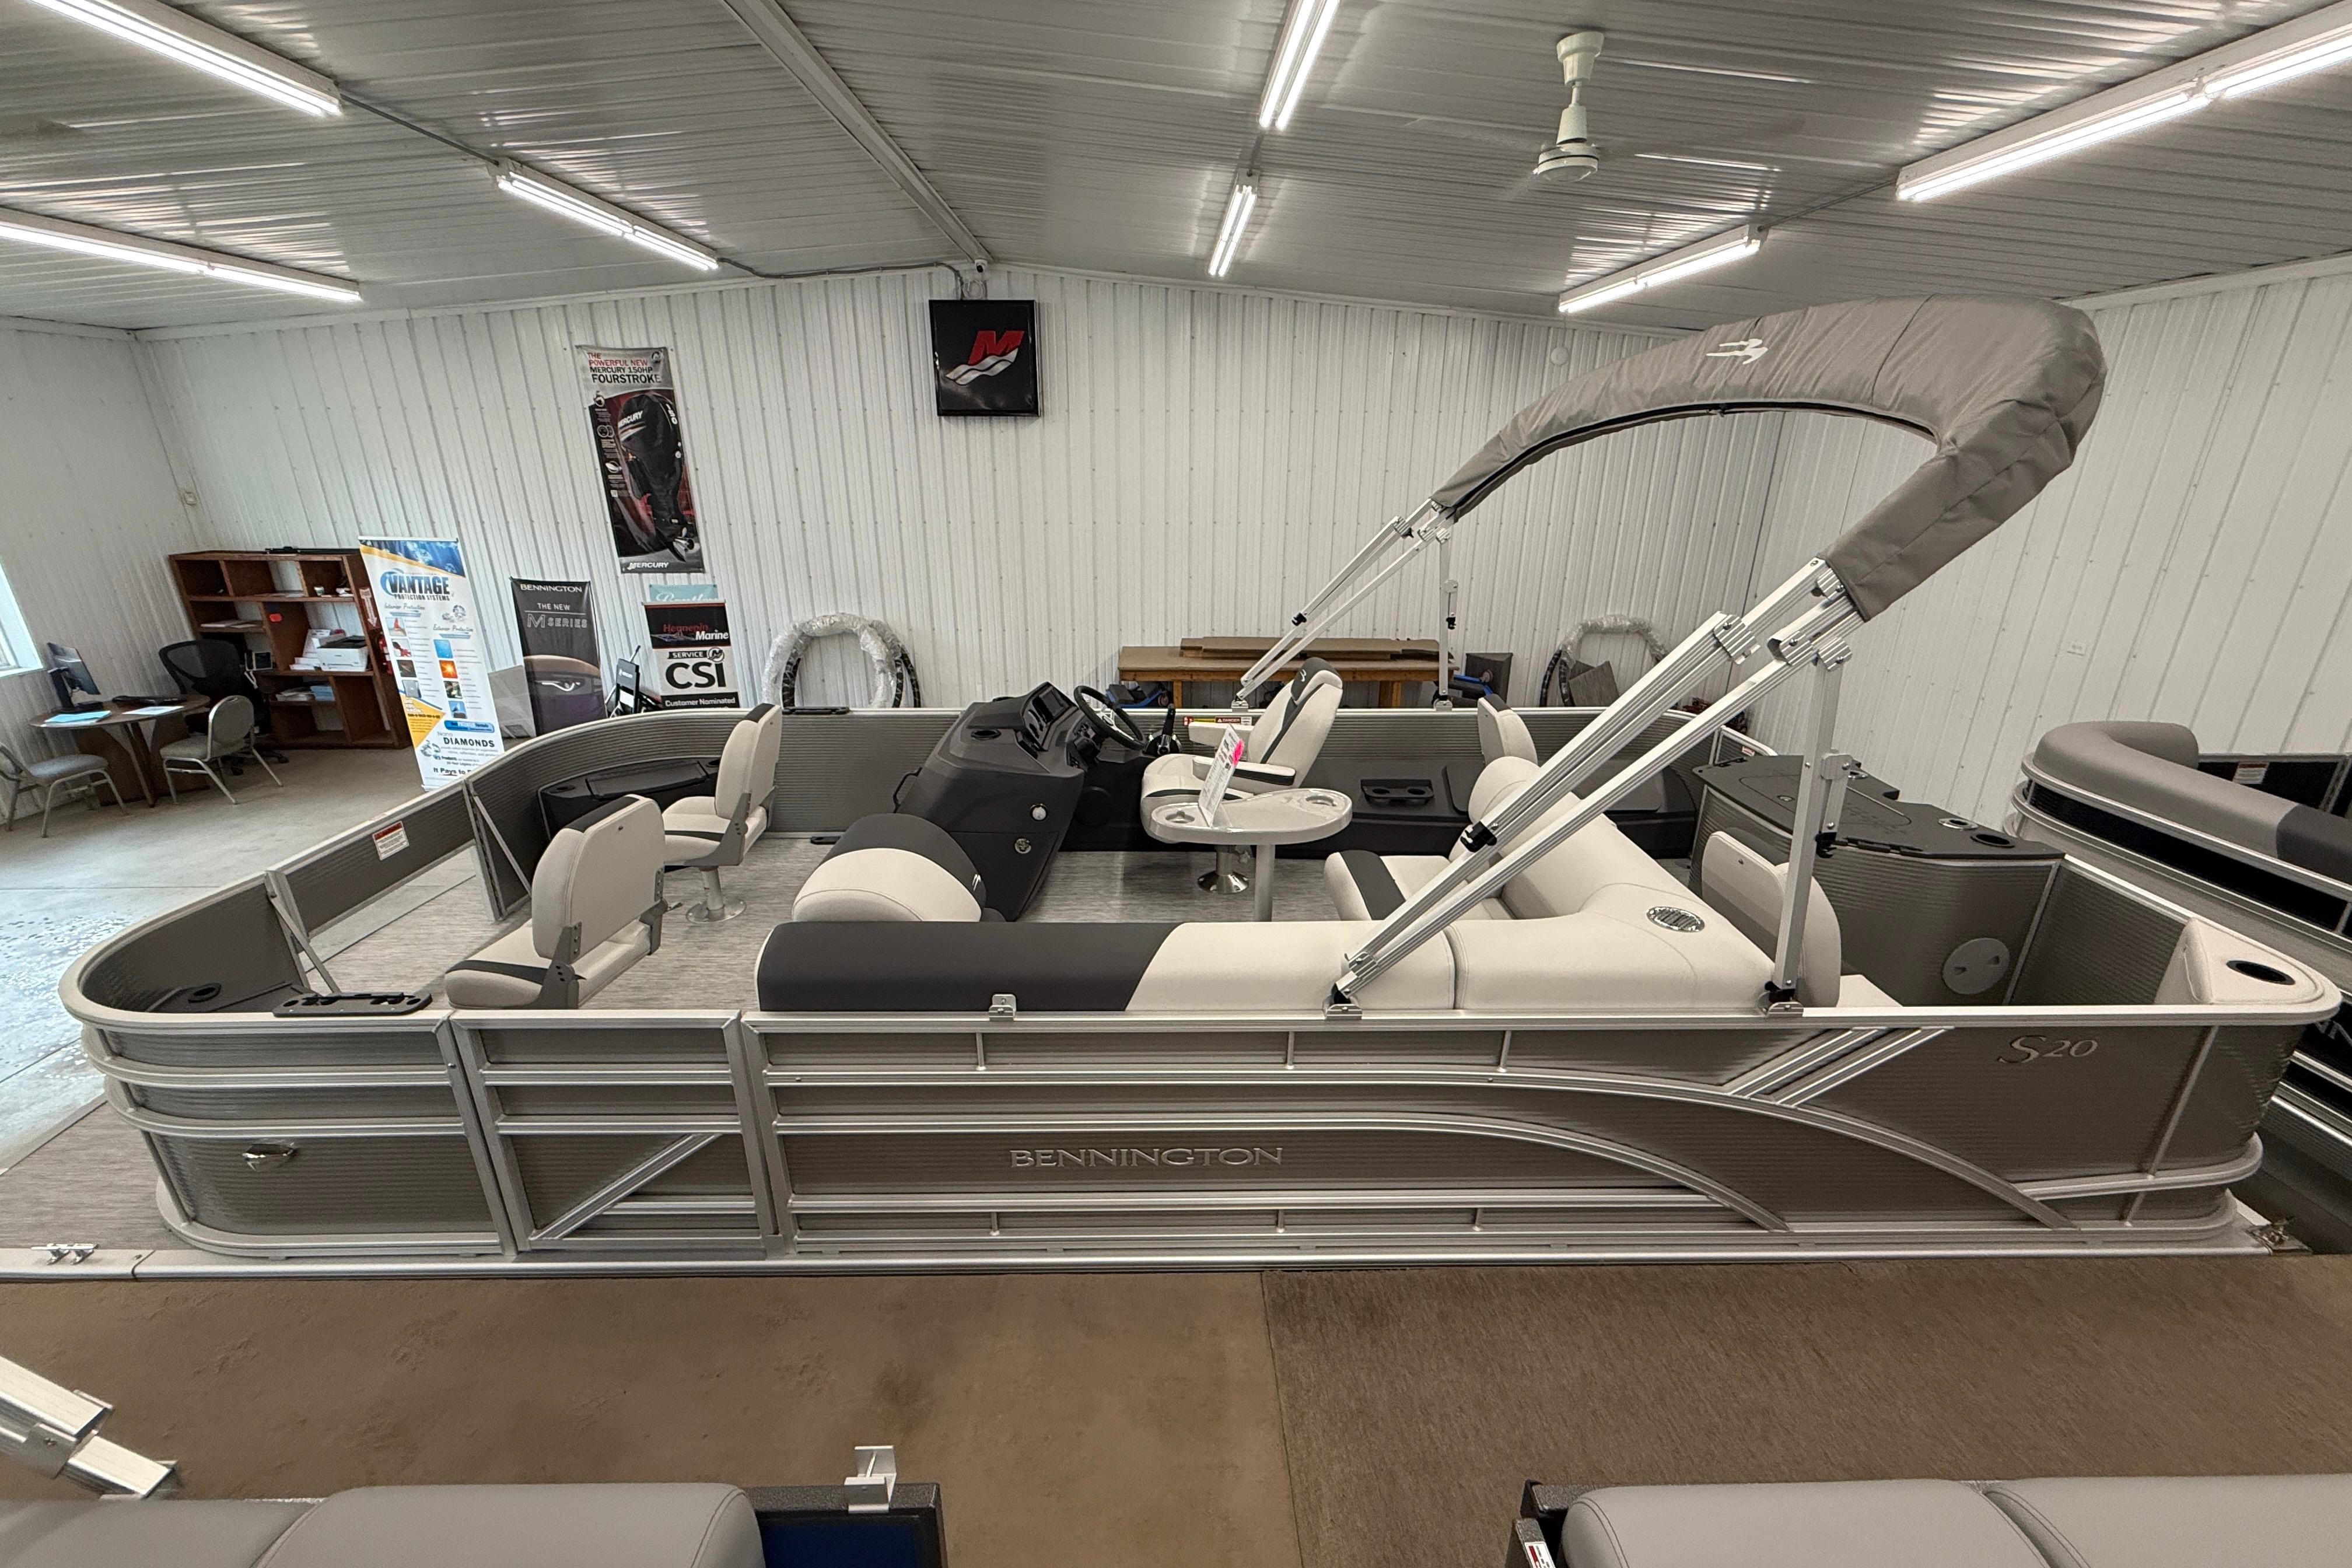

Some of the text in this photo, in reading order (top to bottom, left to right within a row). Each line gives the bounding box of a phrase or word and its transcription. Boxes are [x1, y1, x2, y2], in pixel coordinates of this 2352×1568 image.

[592, 374, 662, 384] FOURSTROKE
[388, 575, 450, 595] VANTAGE
[520, 584, 583, 593] BENNINGTON
[527, 614, 587, 628] M SERIES
[695, 629, 729, 640] Marine
[666, 662, 727, 690] CSI
[699, 697, 736, 705] Nominated
[443, 737, 495, 748] DIAMONDS
[1996, 1034, 2099, 1064] S20
[1009, 1147, 1283, 1168] BENNINGTON
